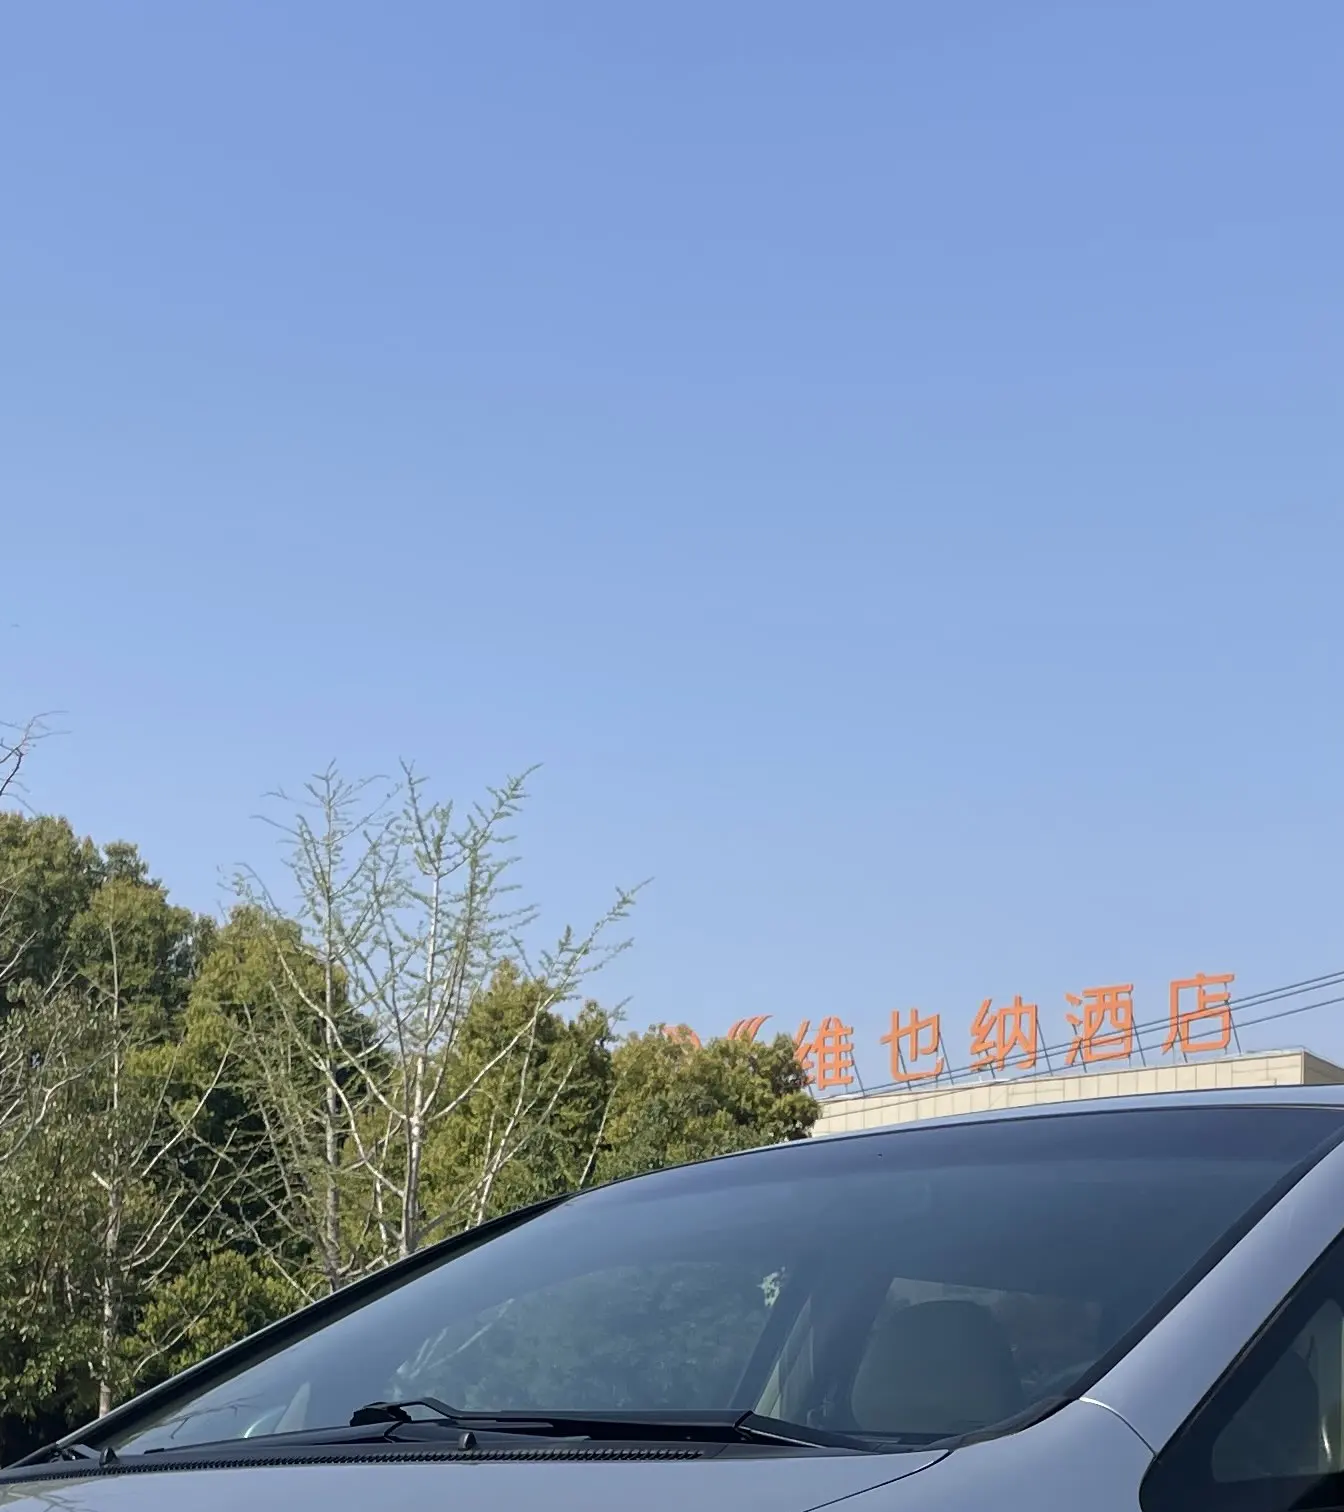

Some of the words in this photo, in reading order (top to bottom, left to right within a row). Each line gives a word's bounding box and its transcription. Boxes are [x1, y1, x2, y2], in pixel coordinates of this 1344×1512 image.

[792, 972, 1235, 1092] 维也纳酒店
